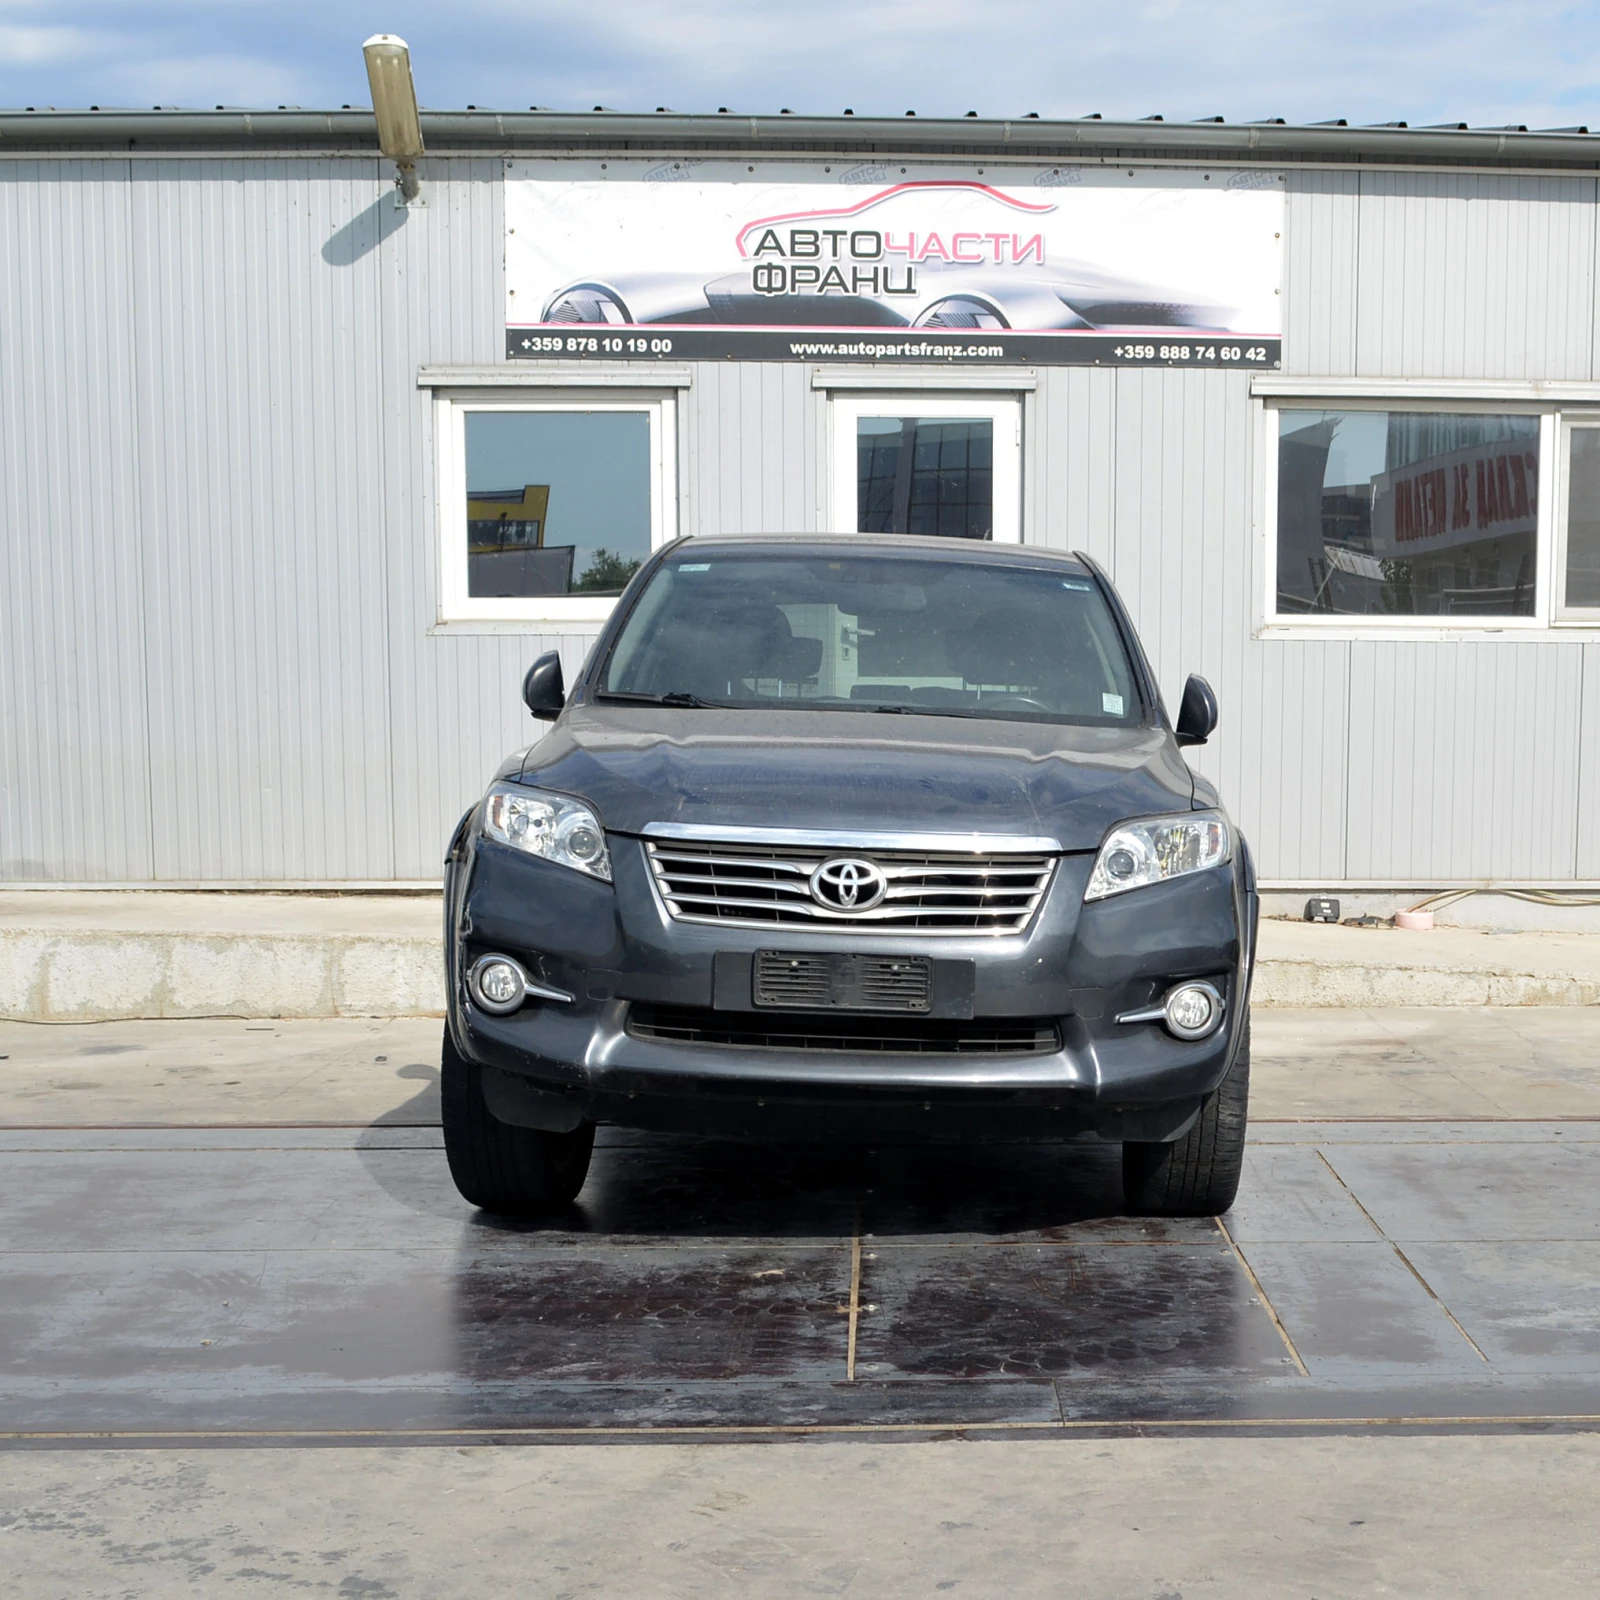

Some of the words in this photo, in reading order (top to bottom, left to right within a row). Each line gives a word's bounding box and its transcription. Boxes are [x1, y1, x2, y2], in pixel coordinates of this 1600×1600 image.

[753, 229, 1043, 262] АВТОЧАСТИ
[753, 262, 917, 295] ФРАНЦ
[521, 337, 563, 351] +359
[566, 338, 598, 351] 878
[602, 338, 623, 352] 10
[627, 338, 648, 352] 19
[651, 339, 672, 353] 00
[790, 342, 1004, 358] www.autopartsfranz.com
[1114, 345, 1155, 359] +359
[1160, 345, 1190, 359] 888
[1195, 346, 1216, 360] 74
[1220, 347, 1241, 360] 60
[1245, 347, 1266, 361] 42
